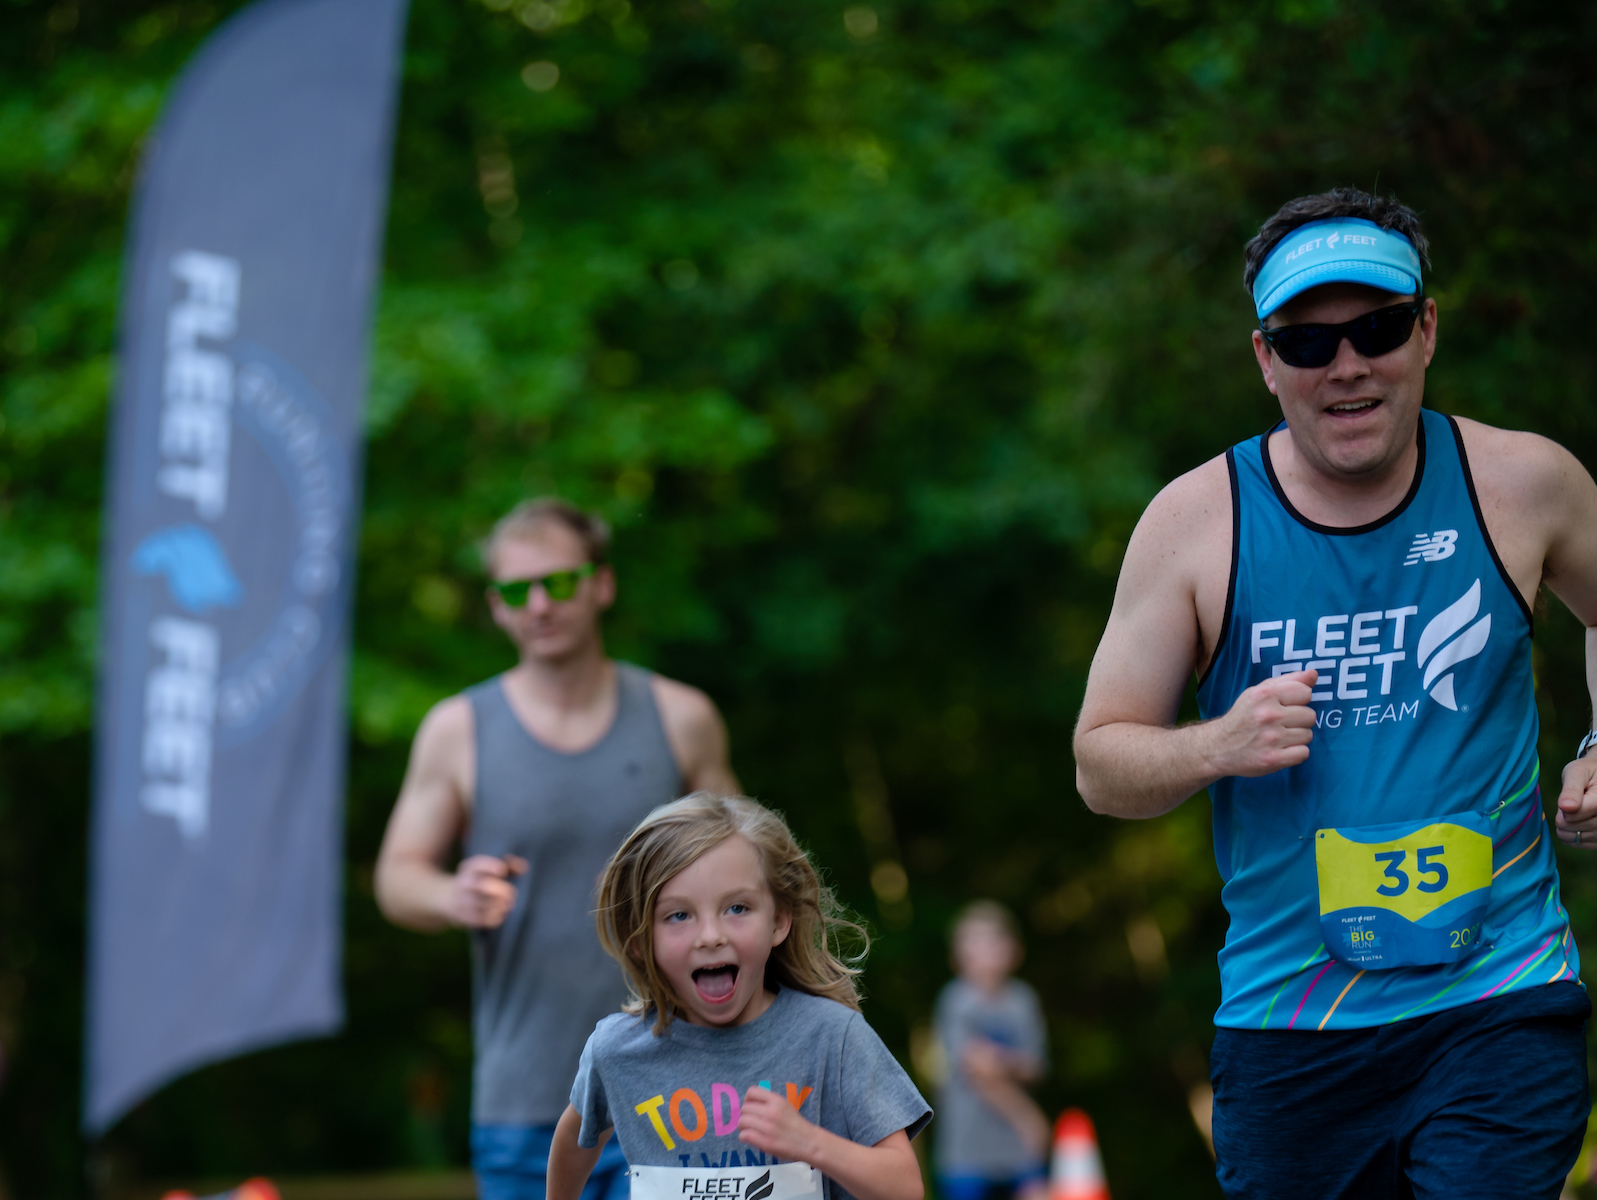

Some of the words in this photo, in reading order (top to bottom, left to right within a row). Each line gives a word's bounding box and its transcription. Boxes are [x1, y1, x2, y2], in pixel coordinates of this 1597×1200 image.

[1286, 238, 1323, 264] FLEET
[1343, 234, 1377, 246] FEET
[156, 248, 242, 521] FLEET
[1250, 605, 1418, 664] FLEET
[140, 614, 220, 840] FEET
[1352, 700, 1420, 727] TEAM
[1374, 845, 1449, 897] 35
[1349, 925, 1364, 933] THE
[1350, 930, 1375, 943] BIG
[1351, 940, 1373, 949] RUN
[634, 1080, 813, 1151] TODY
[700, 1149, 779, 1168] WAN
[681, 1176, 746, 1194] FLEET
